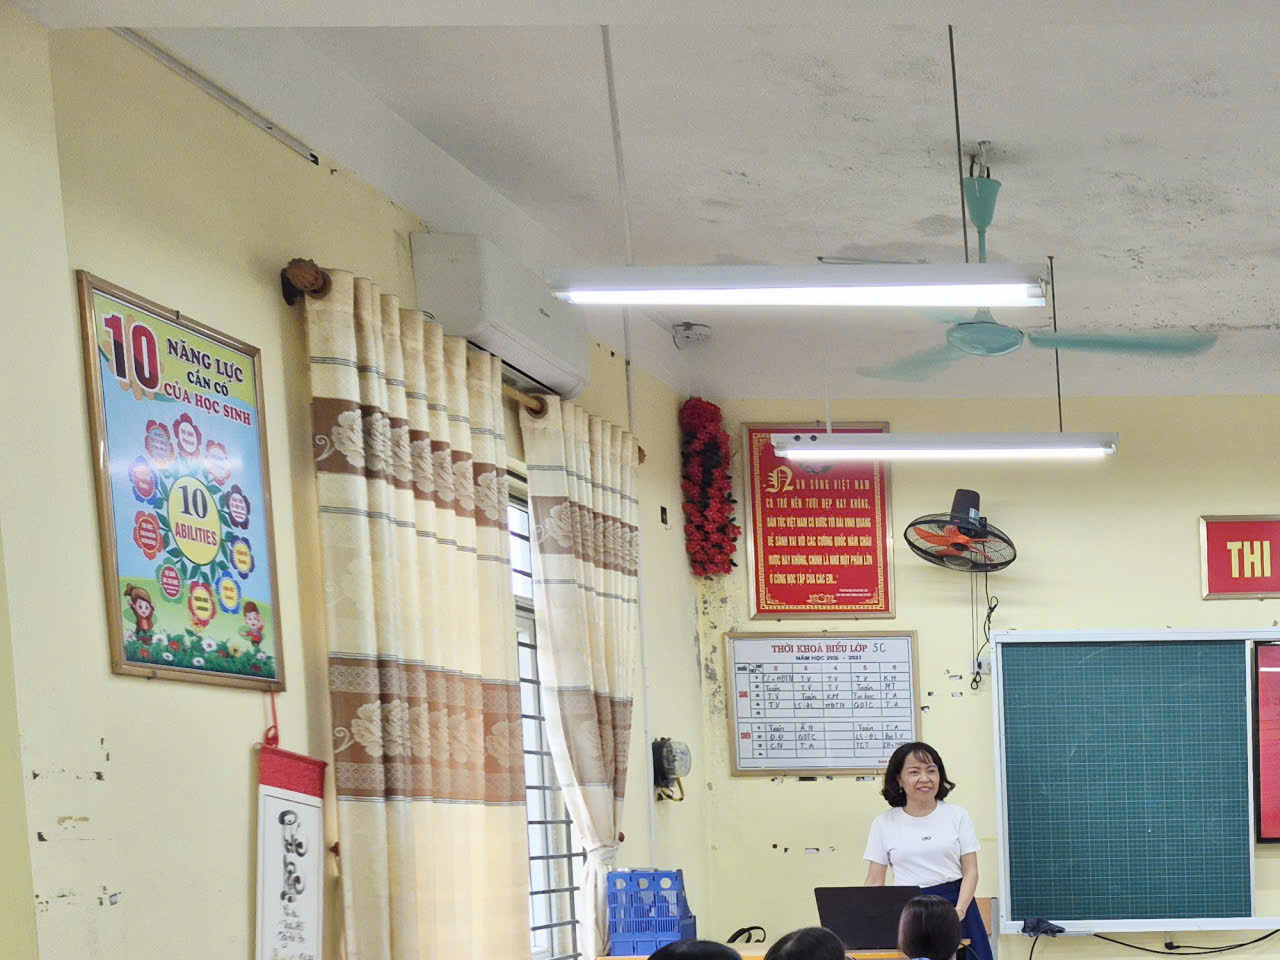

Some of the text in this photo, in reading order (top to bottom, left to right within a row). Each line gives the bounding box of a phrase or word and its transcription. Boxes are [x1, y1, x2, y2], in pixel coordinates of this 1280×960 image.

[104, 313, 160, 392] 10
[168, 338, 243, 384] NĂNG LỰC
[187, 367, 229, 397] CẦN CÓ
[164, 380, 251, 426] CỦA HỌC SINH
[178, 483, 208, 519] 10
[854, 479, 870, 490] NAM
[175, 521, 218, 548] ABILITIES
[1227, 540, 1271, 578] THI
[771, 641, 887, 653] THỜI KHOÁ BIỂU LỚP 5C
